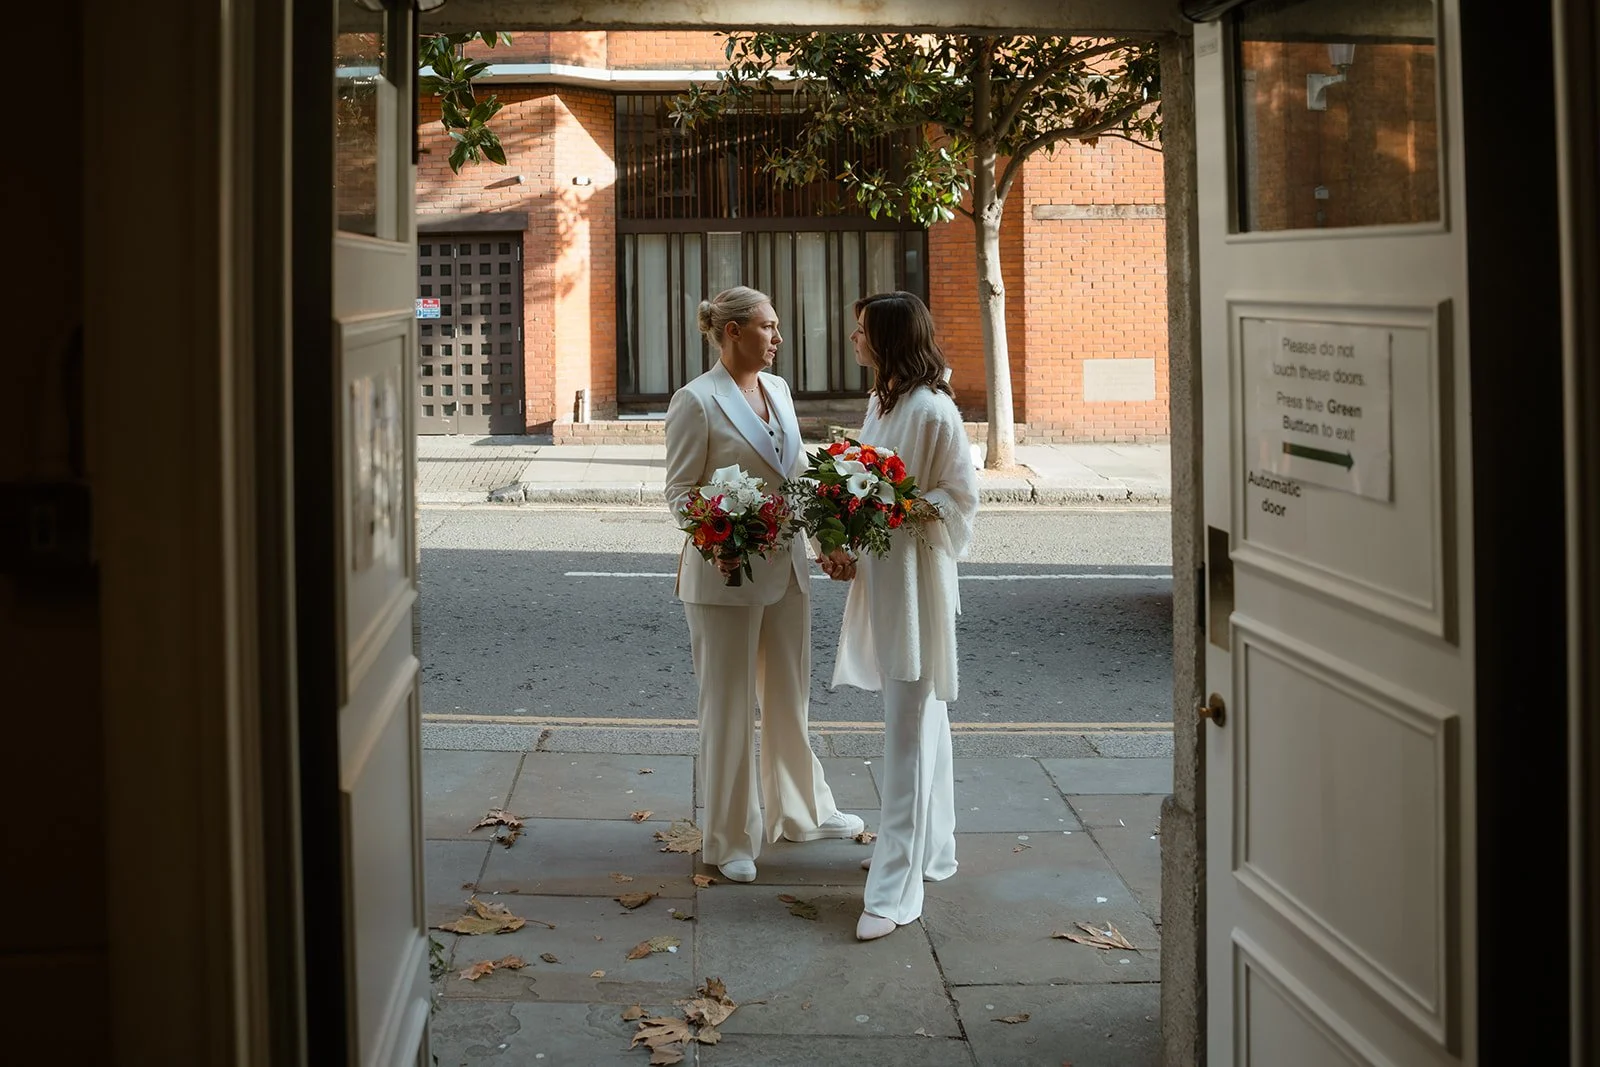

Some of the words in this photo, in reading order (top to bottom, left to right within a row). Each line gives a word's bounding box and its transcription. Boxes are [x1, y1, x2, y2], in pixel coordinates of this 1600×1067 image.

[1282, 337, 1316, 354] Please
[1319, 341, 1335, 356] do
[1337, 344, 1355, 358] not
[1273, 362, 1298, 377] touch
[1299, 365, 1331, 381] these
[1277, 391, 1303, 409] Press
[1305, 396, 1324, 412] the
[1327, 399, 1362, 418] Green
[1282, 415, 1319, 435] Button
[1321, 423, 1334, 438] to
[1335, 426, 1355, 441] exit
[1248, 470, 1301, 498] Automatic
[1261, 498, 1287, 517] door
